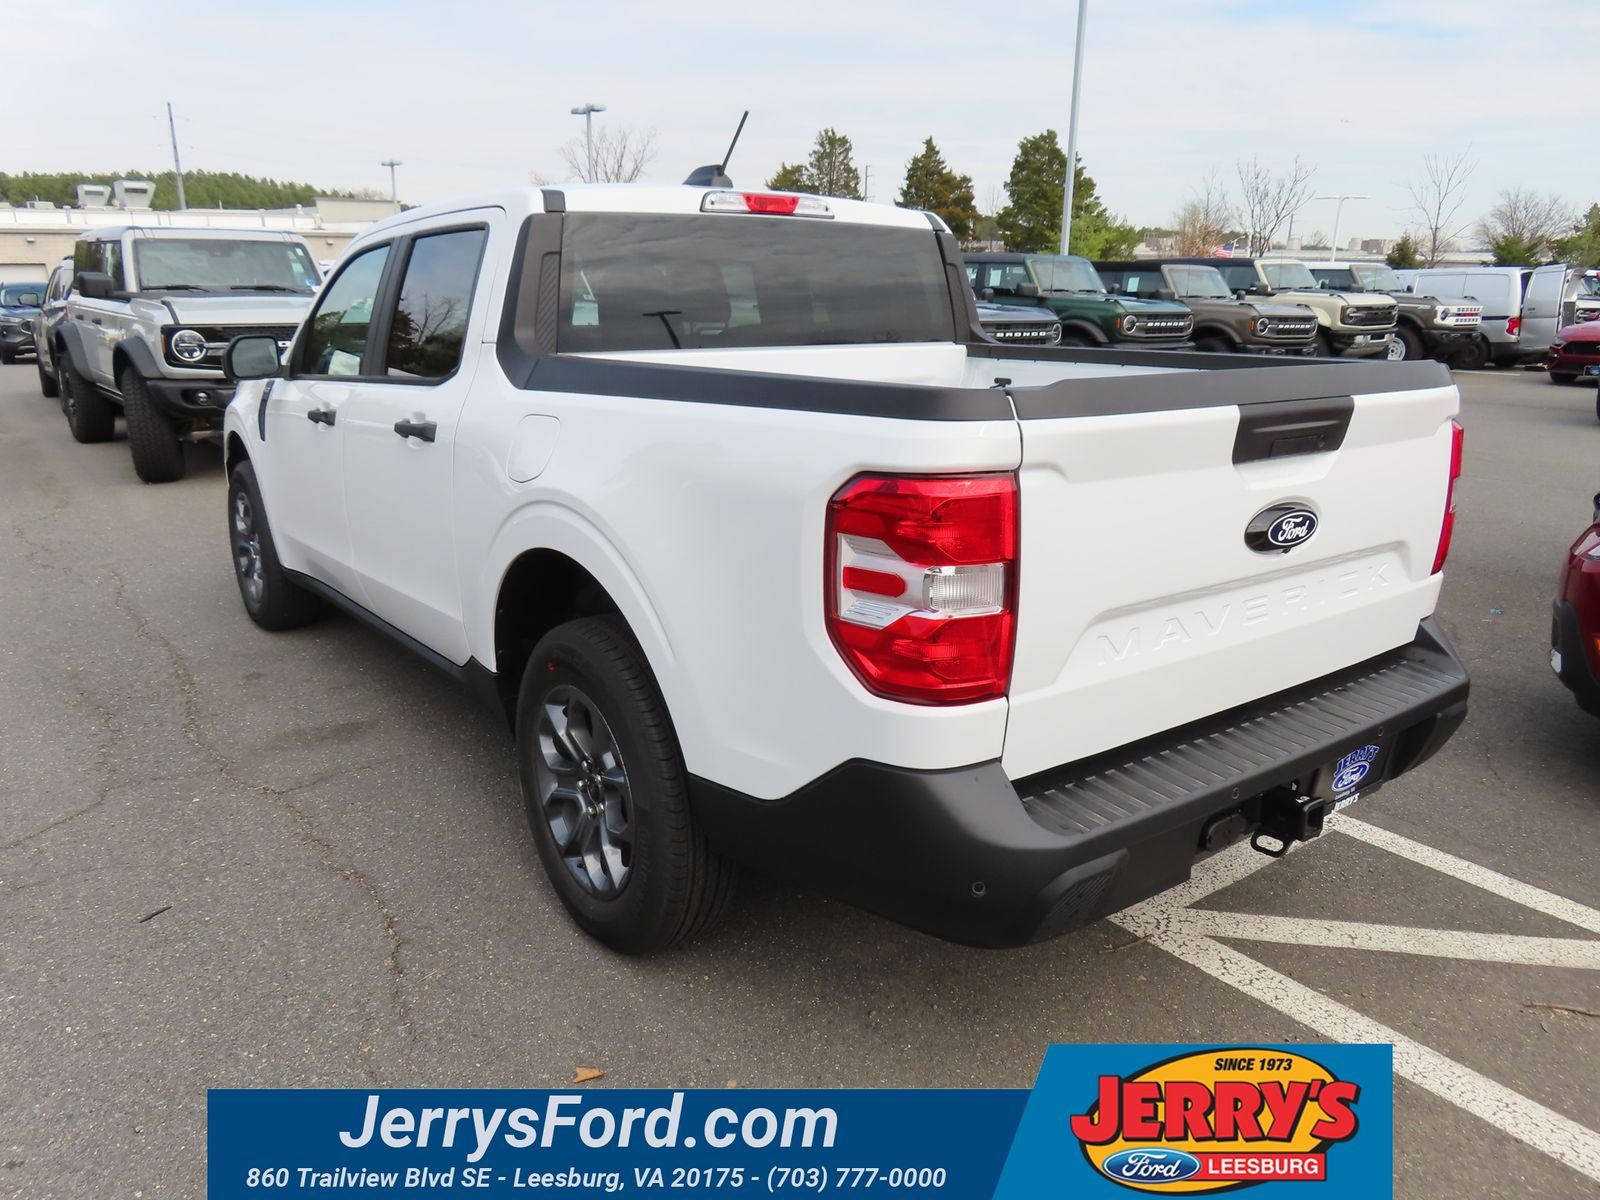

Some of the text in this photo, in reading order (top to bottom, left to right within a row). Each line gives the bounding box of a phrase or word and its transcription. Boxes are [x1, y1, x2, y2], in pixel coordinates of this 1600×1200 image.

[1278, 517, 1309, 541] Ford
[1096, 561, 1391, 666] MAVERICK
[1334, 745, 1380, 777] JERRY'S
[1338, 767, 1364, 787] Ford
